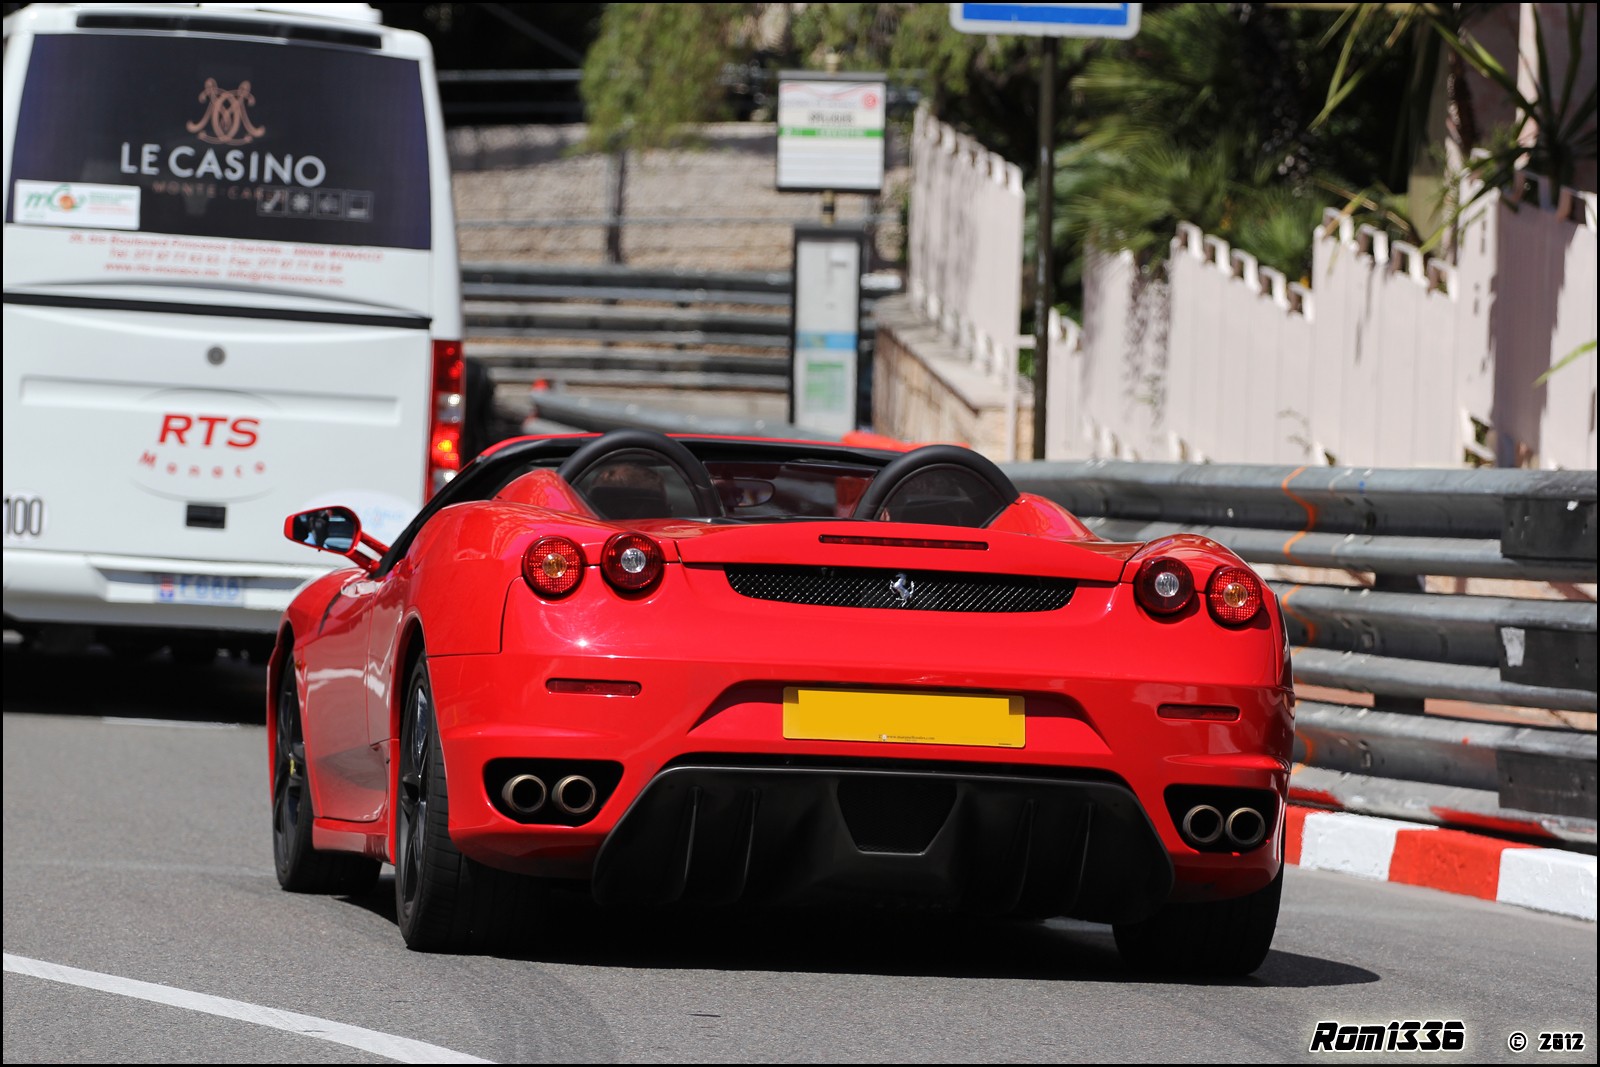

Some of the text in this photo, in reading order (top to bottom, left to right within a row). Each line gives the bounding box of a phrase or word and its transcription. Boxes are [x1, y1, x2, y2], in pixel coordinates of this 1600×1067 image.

[120, 141, 326, 187] LE CASINO
[158, 413, 261, 449] RTS
[4, 497, 44, 537] 100
